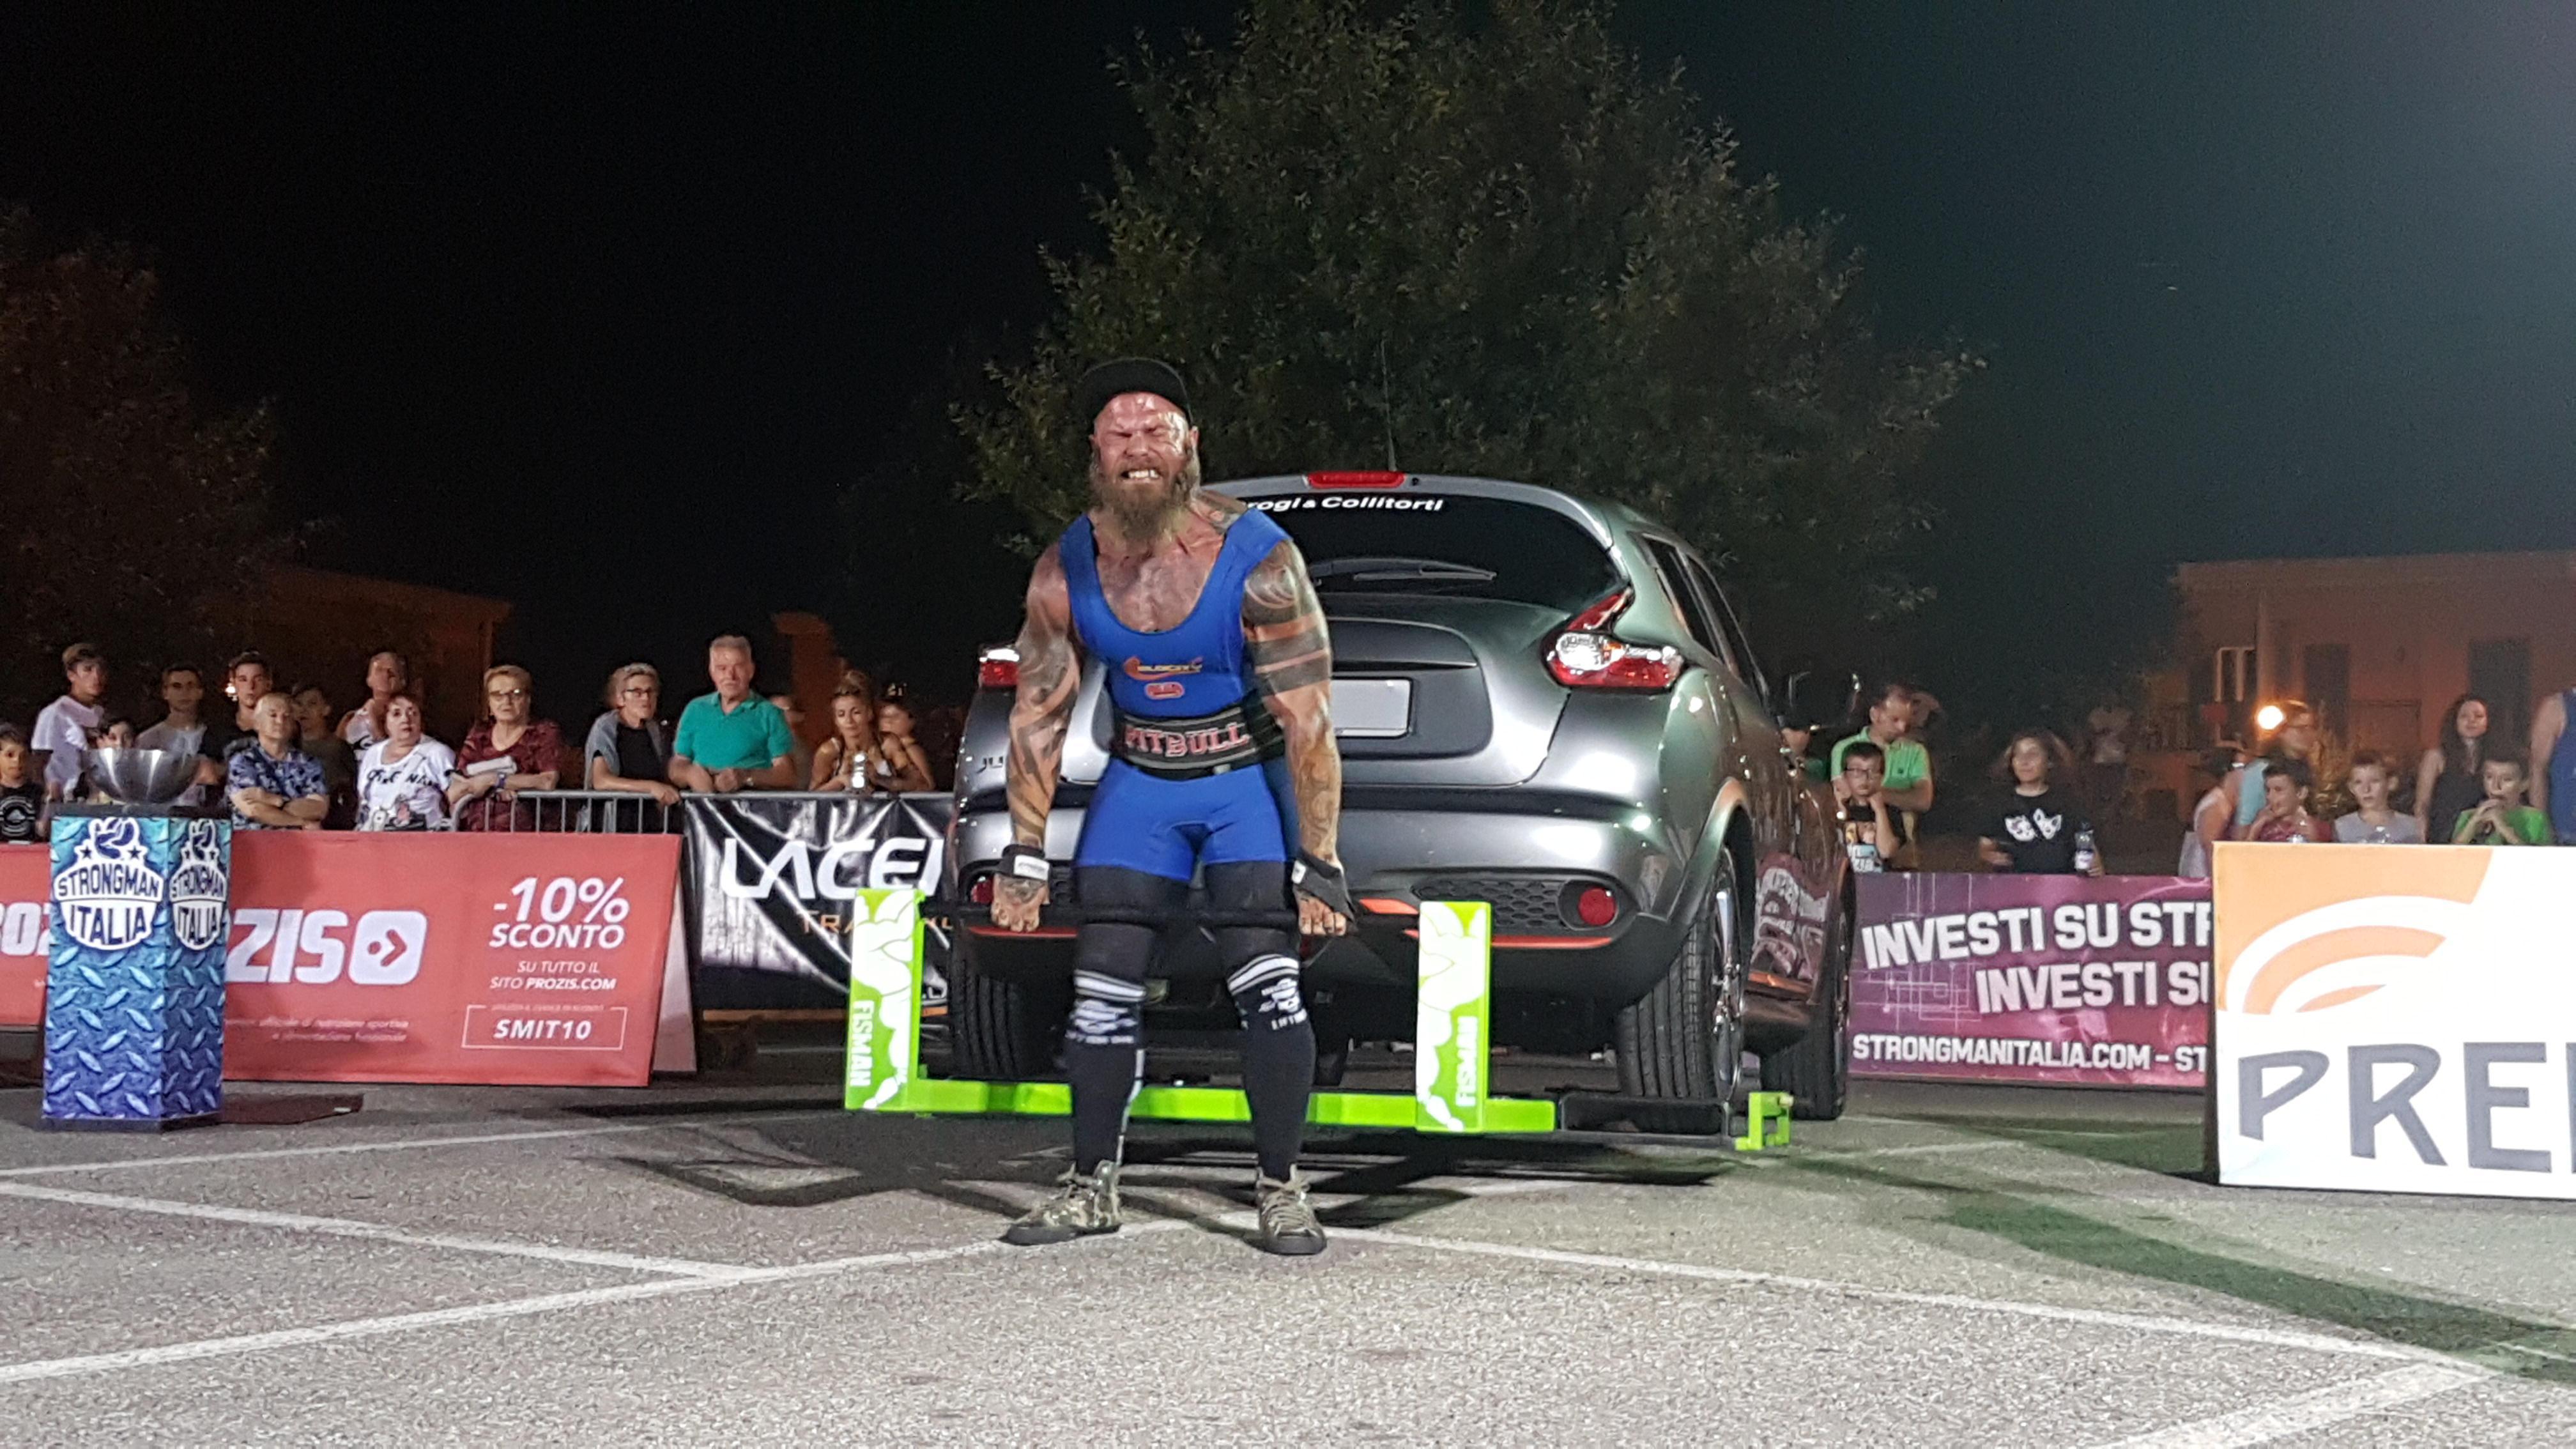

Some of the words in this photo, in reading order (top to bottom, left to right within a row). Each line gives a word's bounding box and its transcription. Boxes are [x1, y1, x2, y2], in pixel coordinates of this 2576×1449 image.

[1321, 496, 1443, 511] Collitorti
[57, 863, 160, 898] STRONGMAN
[493, 877, 630, 923] -10%
[70, 904, 147, 946] ITALIA
[178, 906, 218, 946] ITALIA
[489, 923, 625, 949] SCONTO
[1861, 906, 2044, 970] INVESTI
[2053, 902, 2120, 950] SU
[224, 908, 349, 984] ZIS
[489, 976, 523, 990] SITO
[525, 977, 617, 990] PROZIS.COM
[517, 960, 537, 973] SU
[541, 961, 586, 974] TUTTO
[588, 962, 601, 974] IL
[1975, 961, 2158, 1015] INVESTI
[2167, 961, 2209, 1007] S
[493, 1018, 592, 1040] SMIT10
[1852, 1032, 2151, 1071] STRONGMANITALIA.COM
